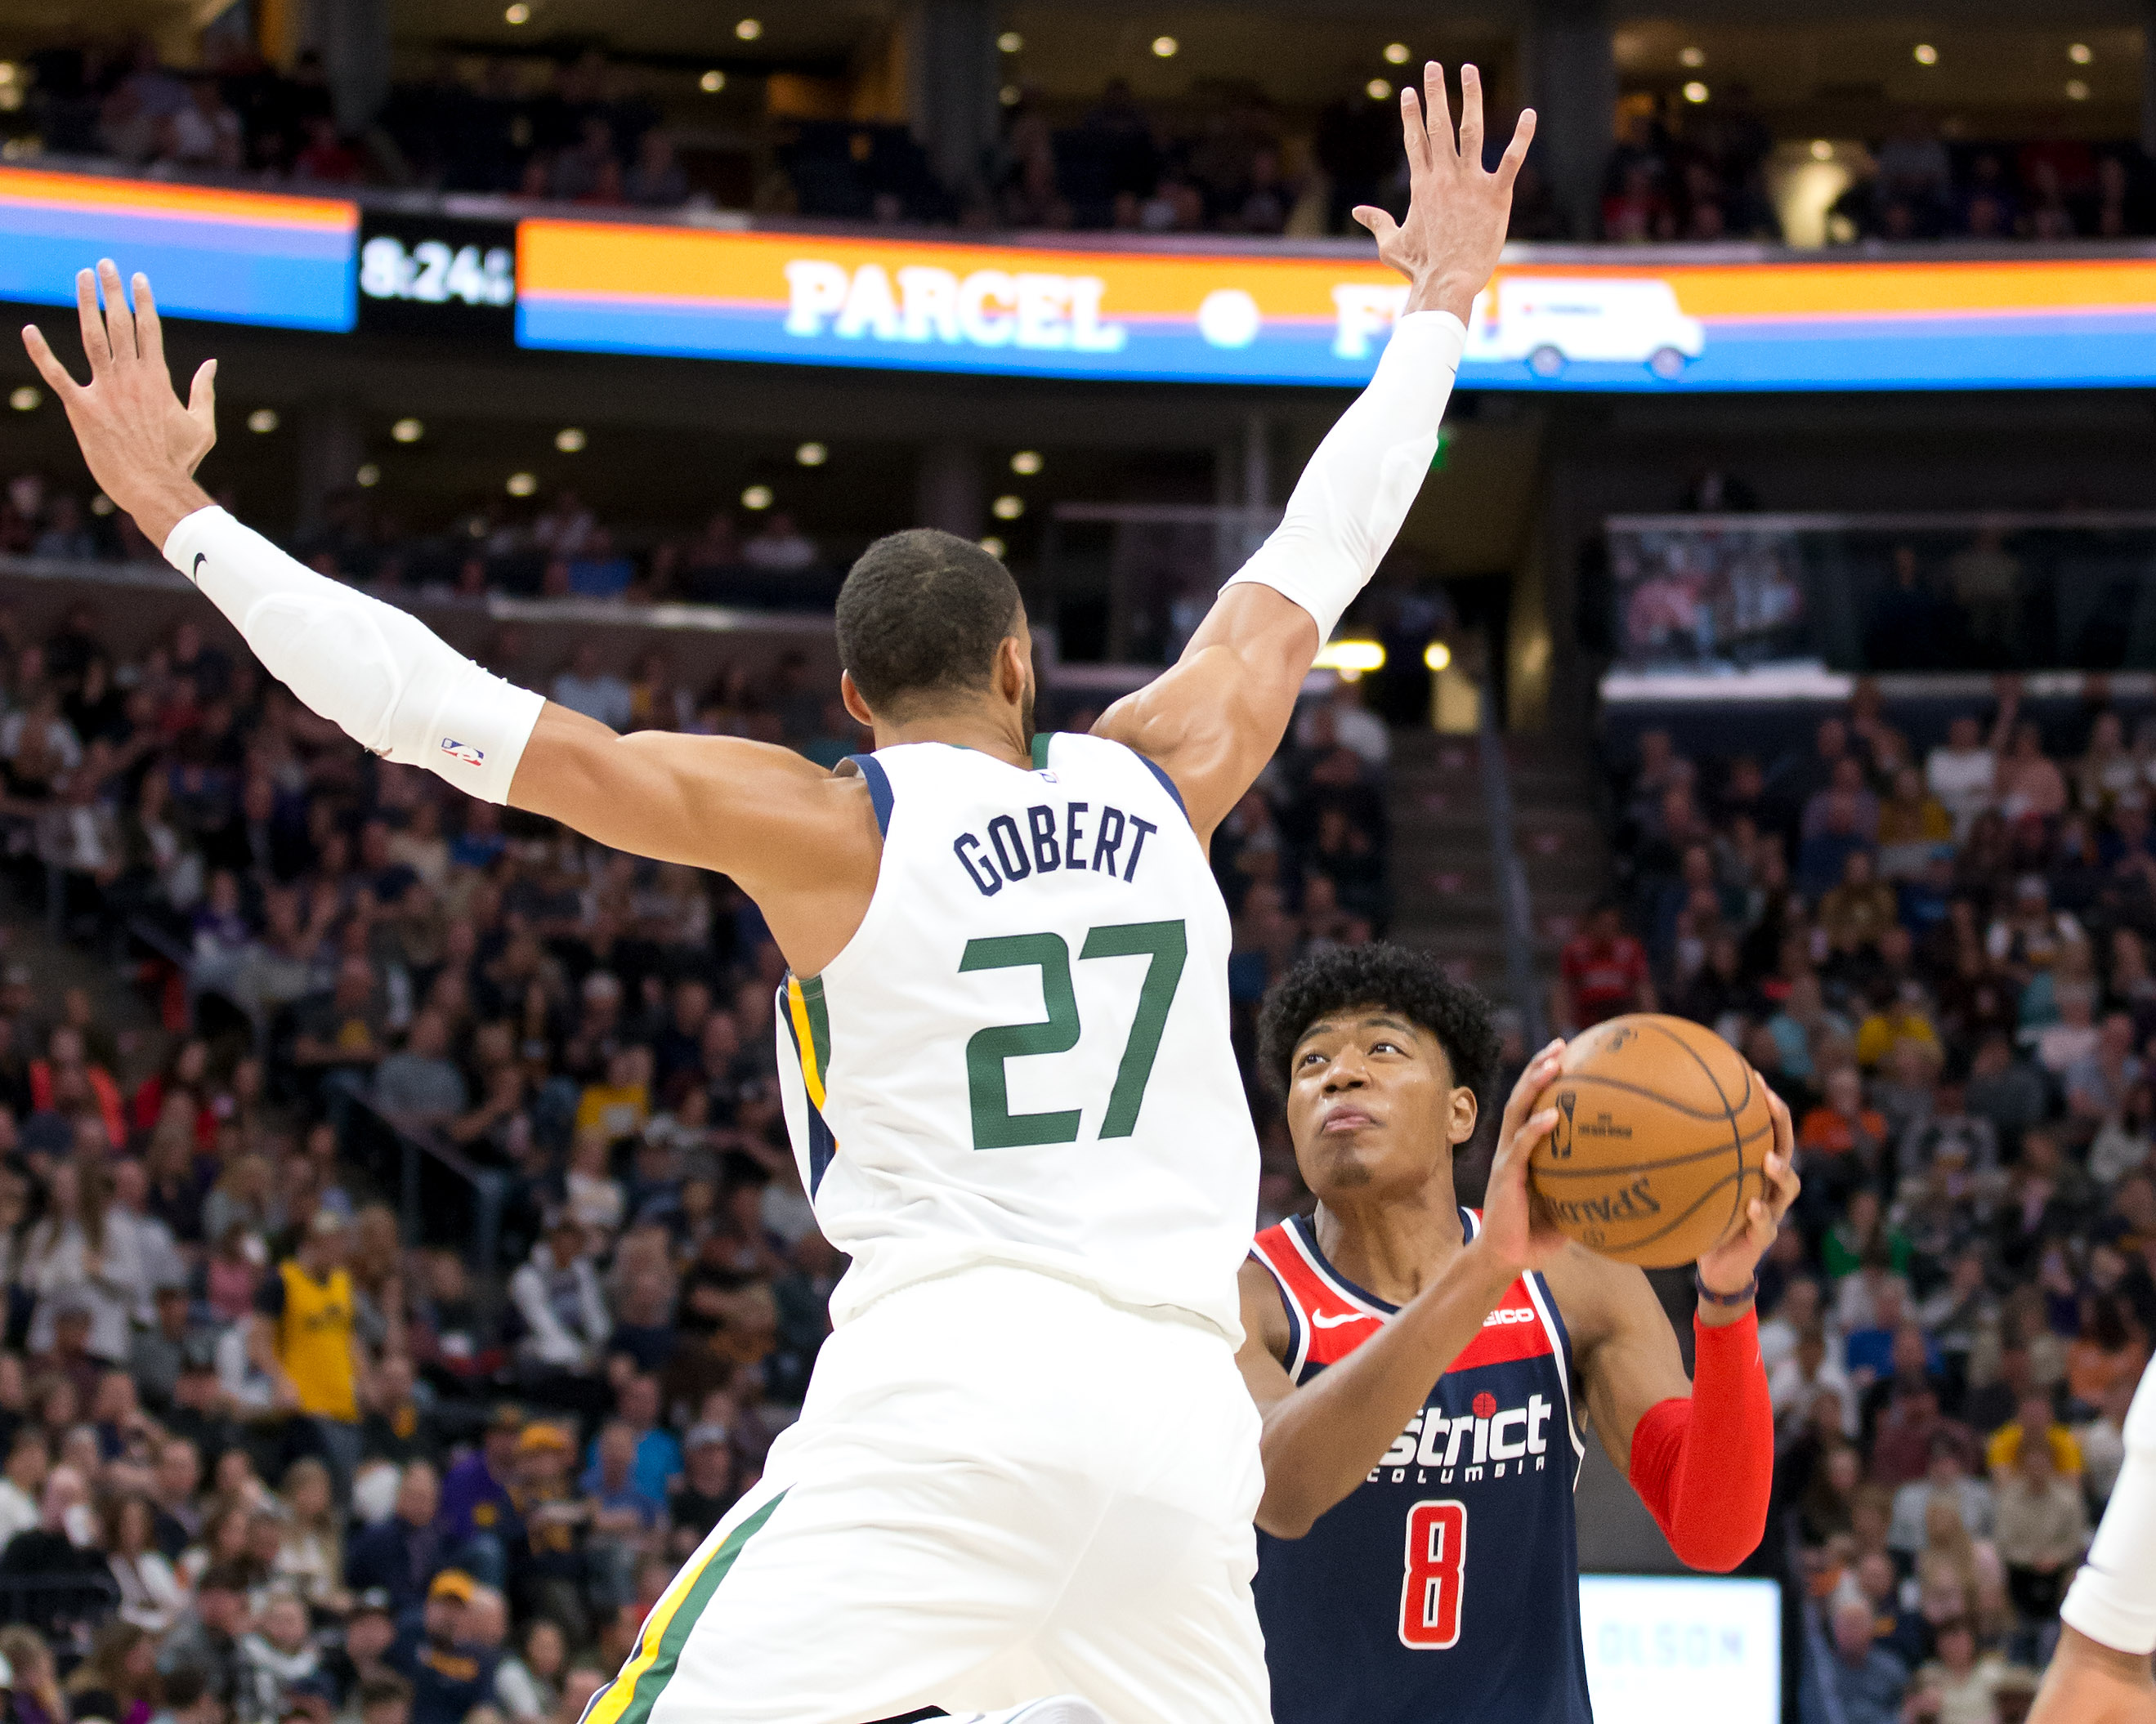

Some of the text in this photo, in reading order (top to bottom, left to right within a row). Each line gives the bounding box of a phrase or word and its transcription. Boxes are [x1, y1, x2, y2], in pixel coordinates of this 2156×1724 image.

[785, 259, 1127, 353] PARCEL
[953, 802, 1157, 897] GOBERT
[957, 918, 1188, 1150] 27
[1483, 1307, 1535, 1327] EICO
[1378, 1391, 1552, 1467] strict
[1398, 1499, 1468, 1650] 8
